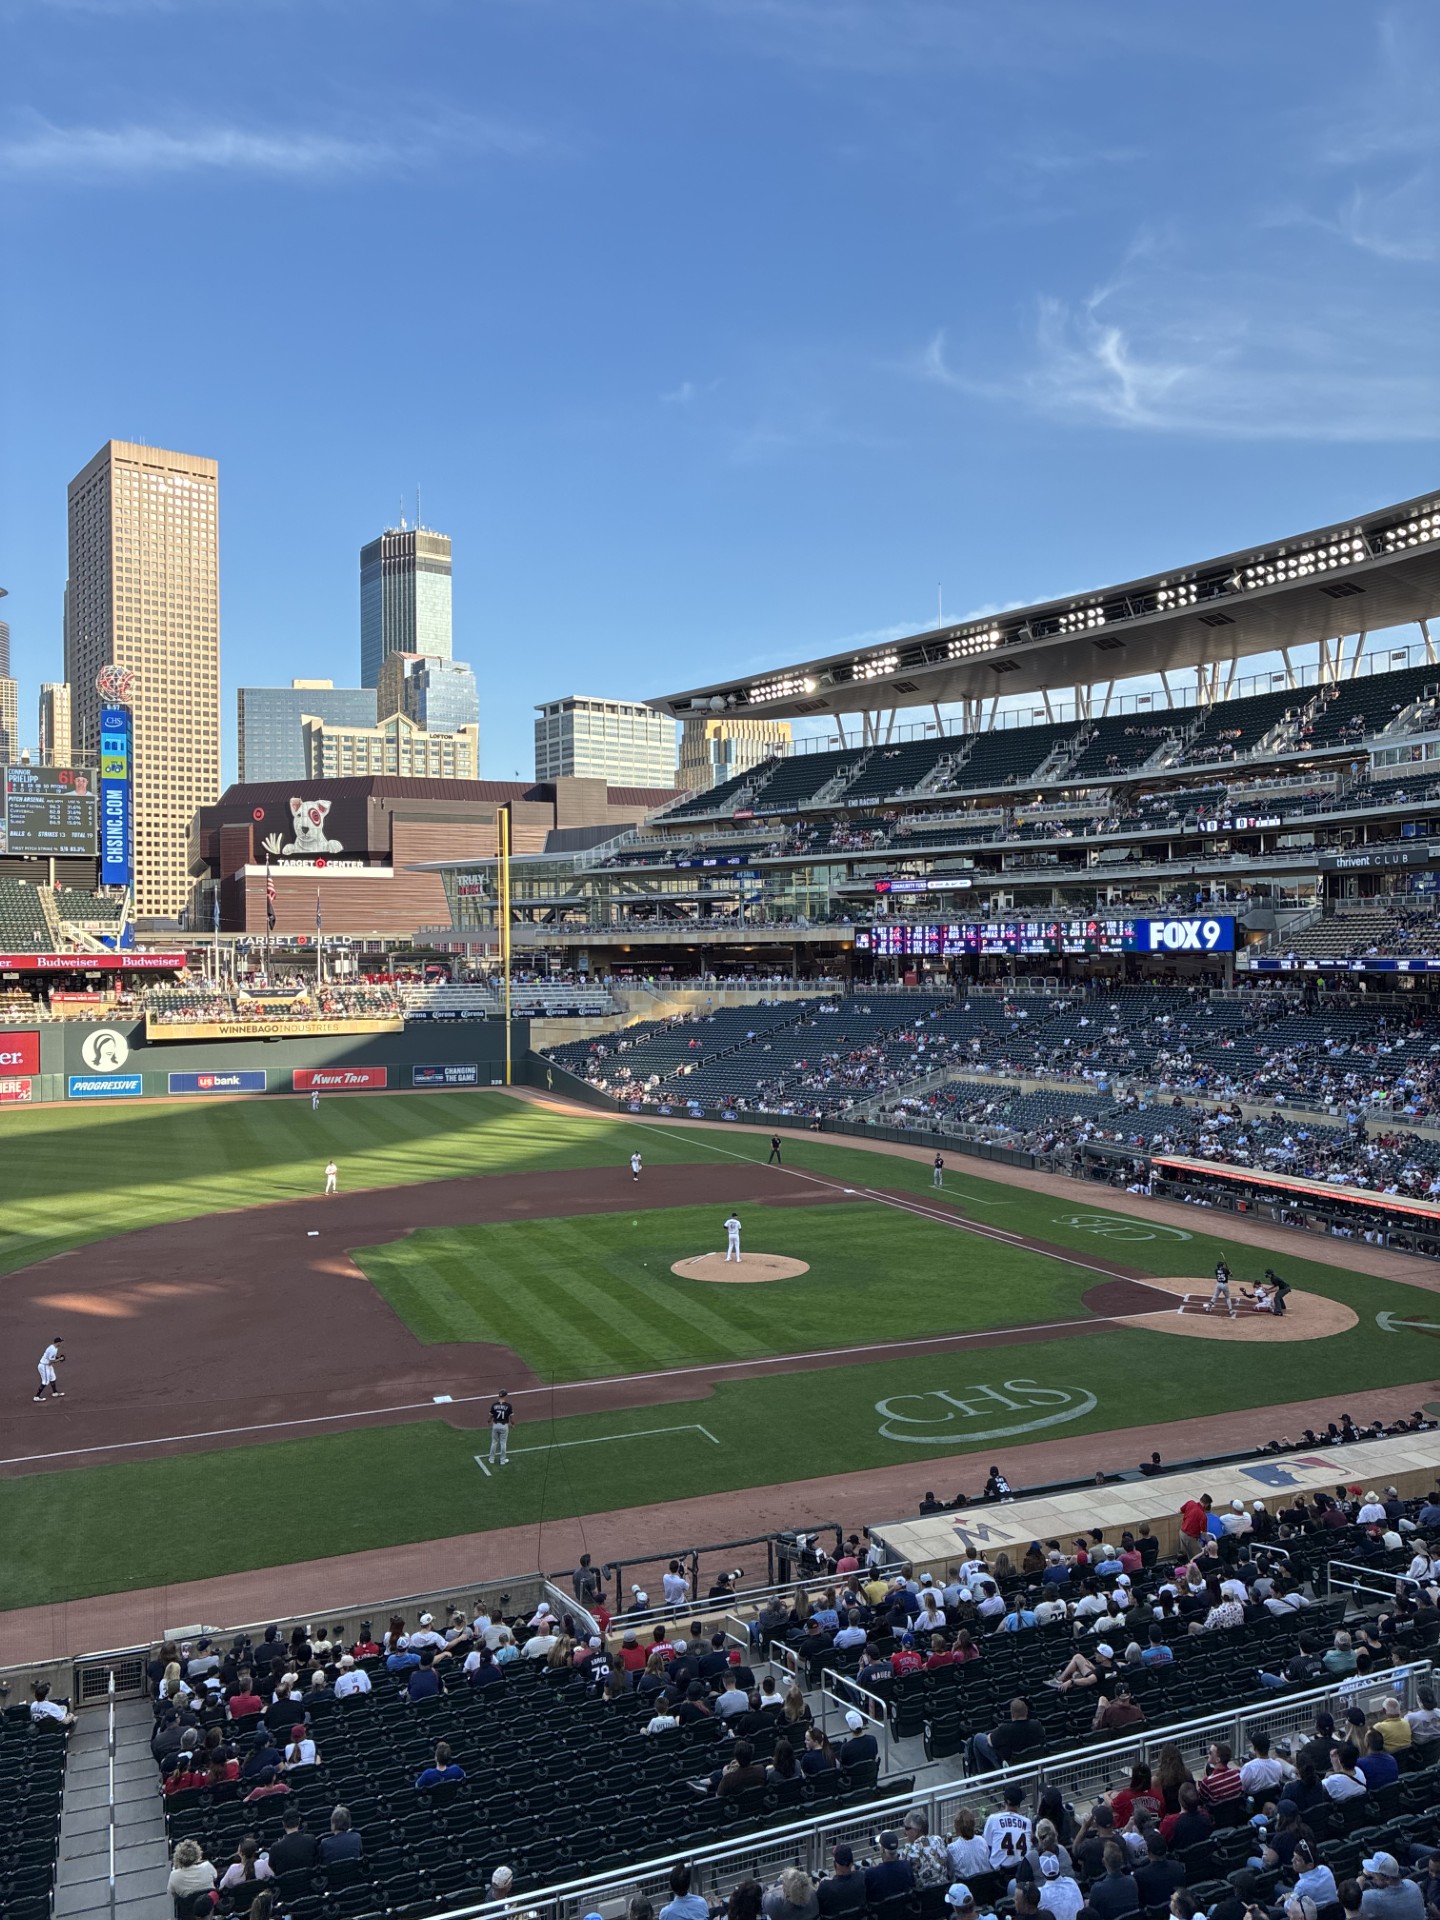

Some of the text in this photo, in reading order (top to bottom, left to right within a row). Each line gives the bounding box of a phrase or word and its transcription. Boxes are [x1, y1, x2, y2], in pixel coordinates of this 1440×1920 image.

[106, 716, 122, 724] CHS
[8, 775, 39, 783] PRIELIPP
[58, 770, 75, 784] 61
[848, 797, 880, 807] END RACISM
[107, 789, 124, 864] CHSINC.COM
[277, 859, 364, 869] TARGET CENTER
[1336, 854, 1409, 868] thrivent CLUB
[457, 873, 485, 886] TRULY
[891, 882, 916, 890] COMMUNITY
[237, 935, 353, 945] TARGET FIELD
[913, 932, 923, 940] PHI
[1150, 921, 1221, 949] FOX 9
[37, 957, 99, 967] Budweiser
[122, 957, 180, 966] Budweiser
[403, 1011, 427, 1019] Corona
[432, 1011, 455, 1019] Corona
[461, 1010, 484, 1018] Corona
[512, 1008, 535, 1016] Corona
[546, 1008, 568, 1016] Corona
[578, 1007, 601, 1015] Corona
[219, 1023, 339, 1034] WINNEBAGO INDUSTRIES
[444, 1067, 476, 1075] CHANGING
[200, 1075, 241, 1086] us bank
[311, 1072, 369, 1085] KWIK TRIP
[445, 1074, 475, 1082] THE GAME
[73, 1080, 139, 1091] PROGRESSIVE
[1217, 1273, 1226, 1282] 25
[875, 1379, 1072, 1424] CHS
[496, 1410, 505, 1420] 71
[952, 1522, 1016, 1549] M
[591, 1656, 607, 1665] ABREU
[871, 1671, 891, 1681] MAUER
[999, 1817, 1028, 1831] GIBSON
[1001, 1831, 1028, 1858] 44
